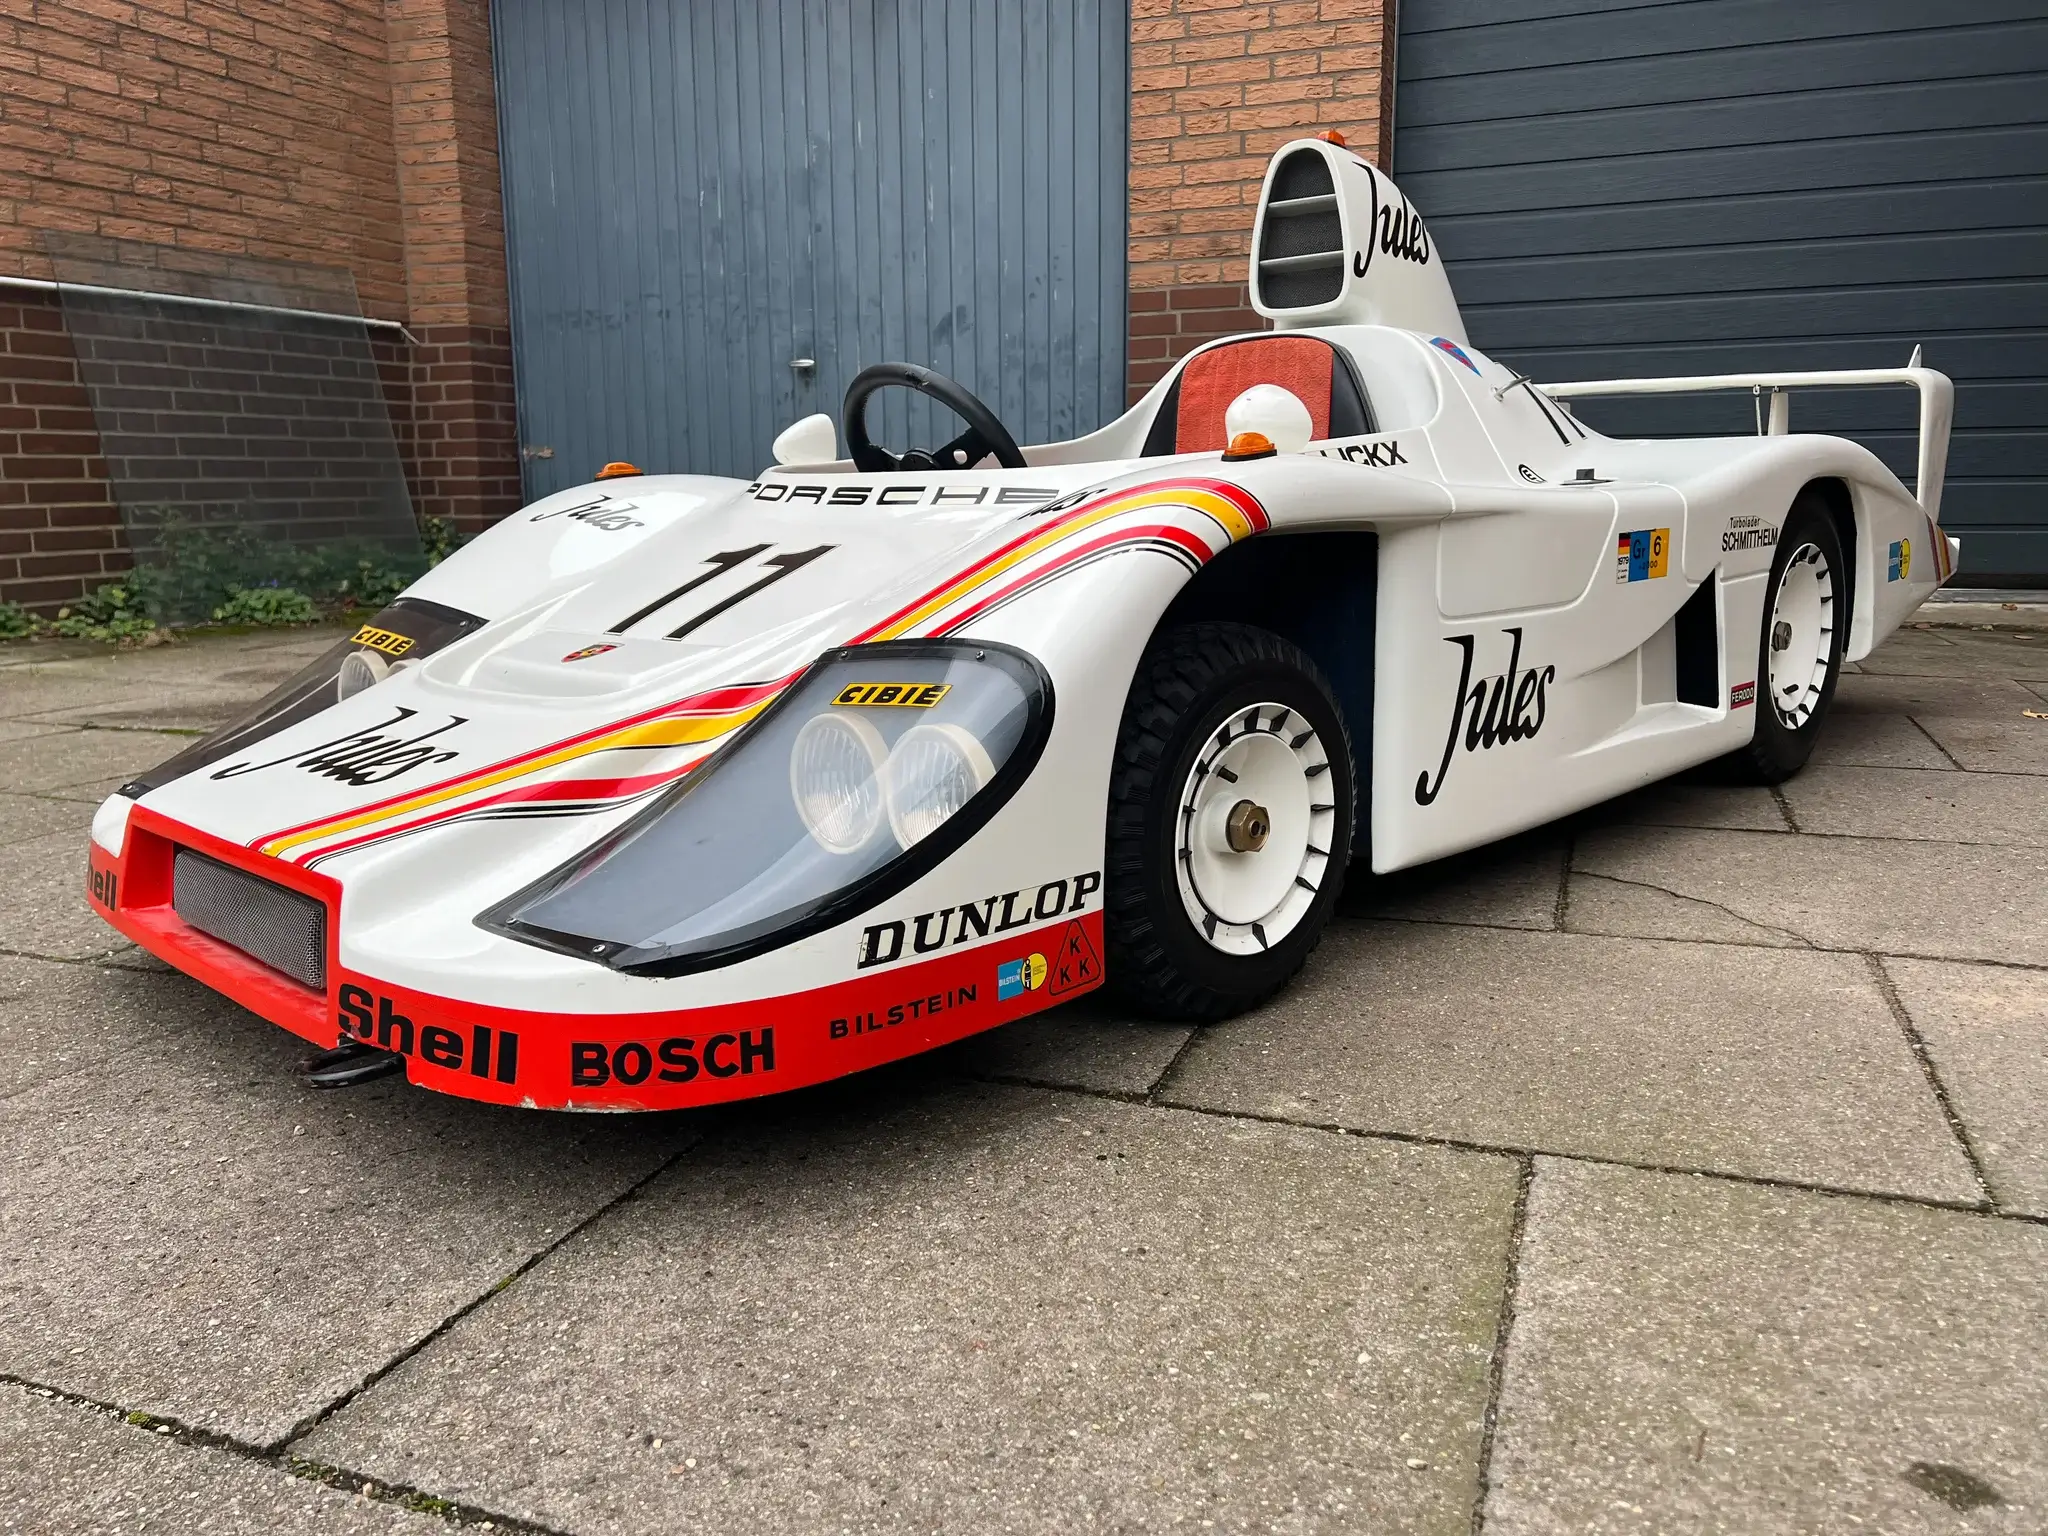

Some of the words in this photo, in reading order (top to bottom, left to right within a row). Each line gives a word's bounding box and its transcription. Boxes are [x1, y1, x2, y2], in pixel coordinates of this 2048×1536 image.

[1352, 160, 1430, 278] Jules
[530, 495, 645, 534] Jules
[1730, 515, 1761, 529] Turbolader
[1653, 535, 1662, 557] 6
[604, 542, 841, 641] 11
[1415, 627, 1555, 806] Jules
[1731, 686, 1754, 704] FERODO
[211, 706, 469, 787] Jules
[87, 855, 117, 912] hell
[857, 870, 1101, 969] DUNLOP
[337, 983, 518, 1085] Shell
[829, 984, 977, 1039] BILSTEIN
[572, 1026, 775, 1086] BOSCH
